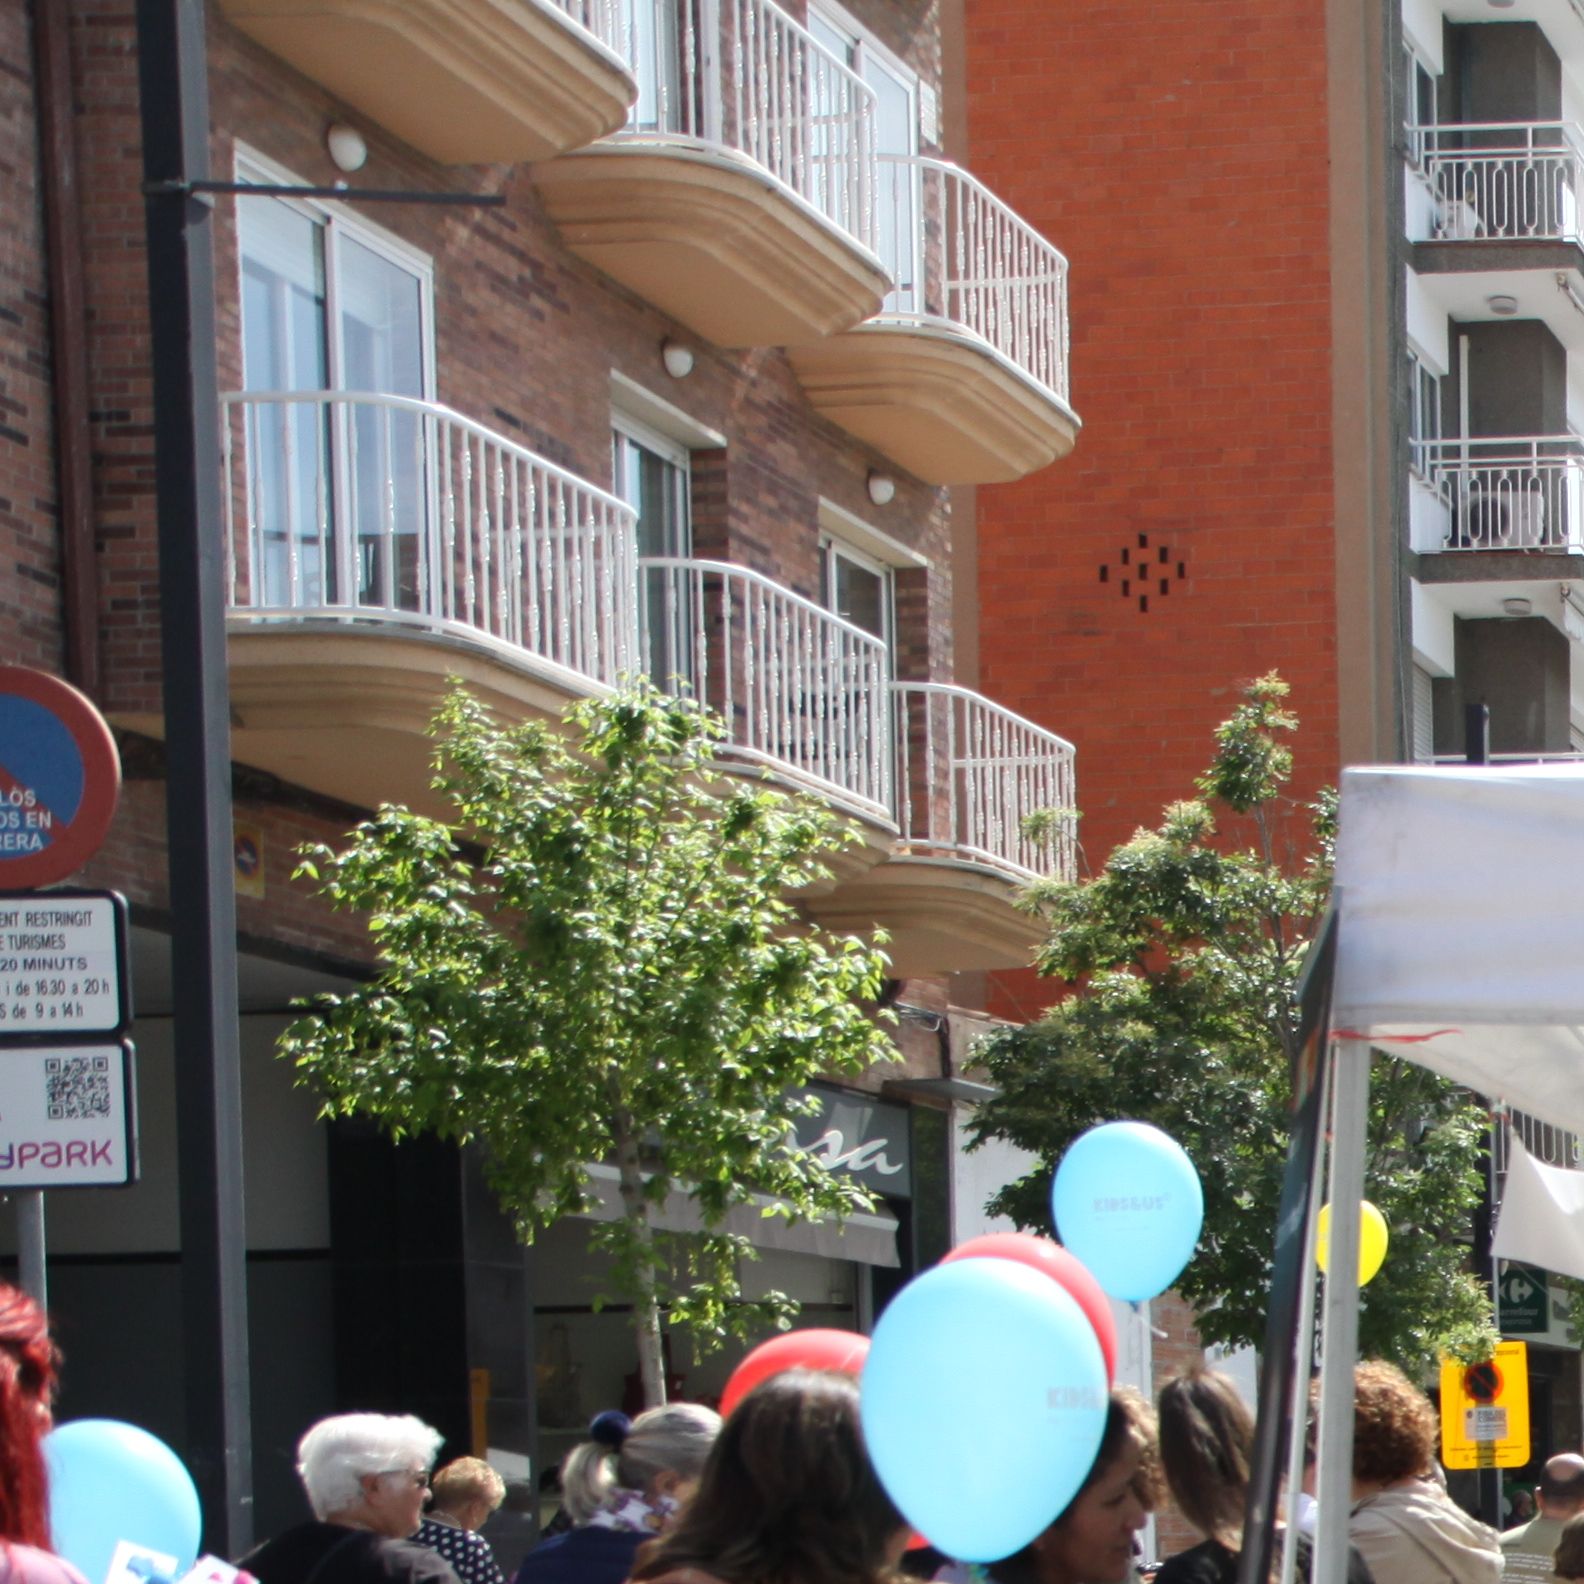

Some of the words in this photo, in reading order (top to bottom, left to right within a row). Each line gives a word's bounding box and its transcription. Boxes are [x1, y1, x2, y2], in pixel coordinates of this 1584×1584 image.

[26, 811, 51, 829] EN
[26, 911, 92, 927] RESTRINGIT
[9, 934, 66, 950] TURISMES
[23, 958, 88, 971] MINUTS
[16, 980, 30, 996] de
[72, 983, 79, 995] a
[12, 1003, 27, 1018] de
[35, 1002, 44, 1018] 9
[50, 1005, 57, 1018] a
